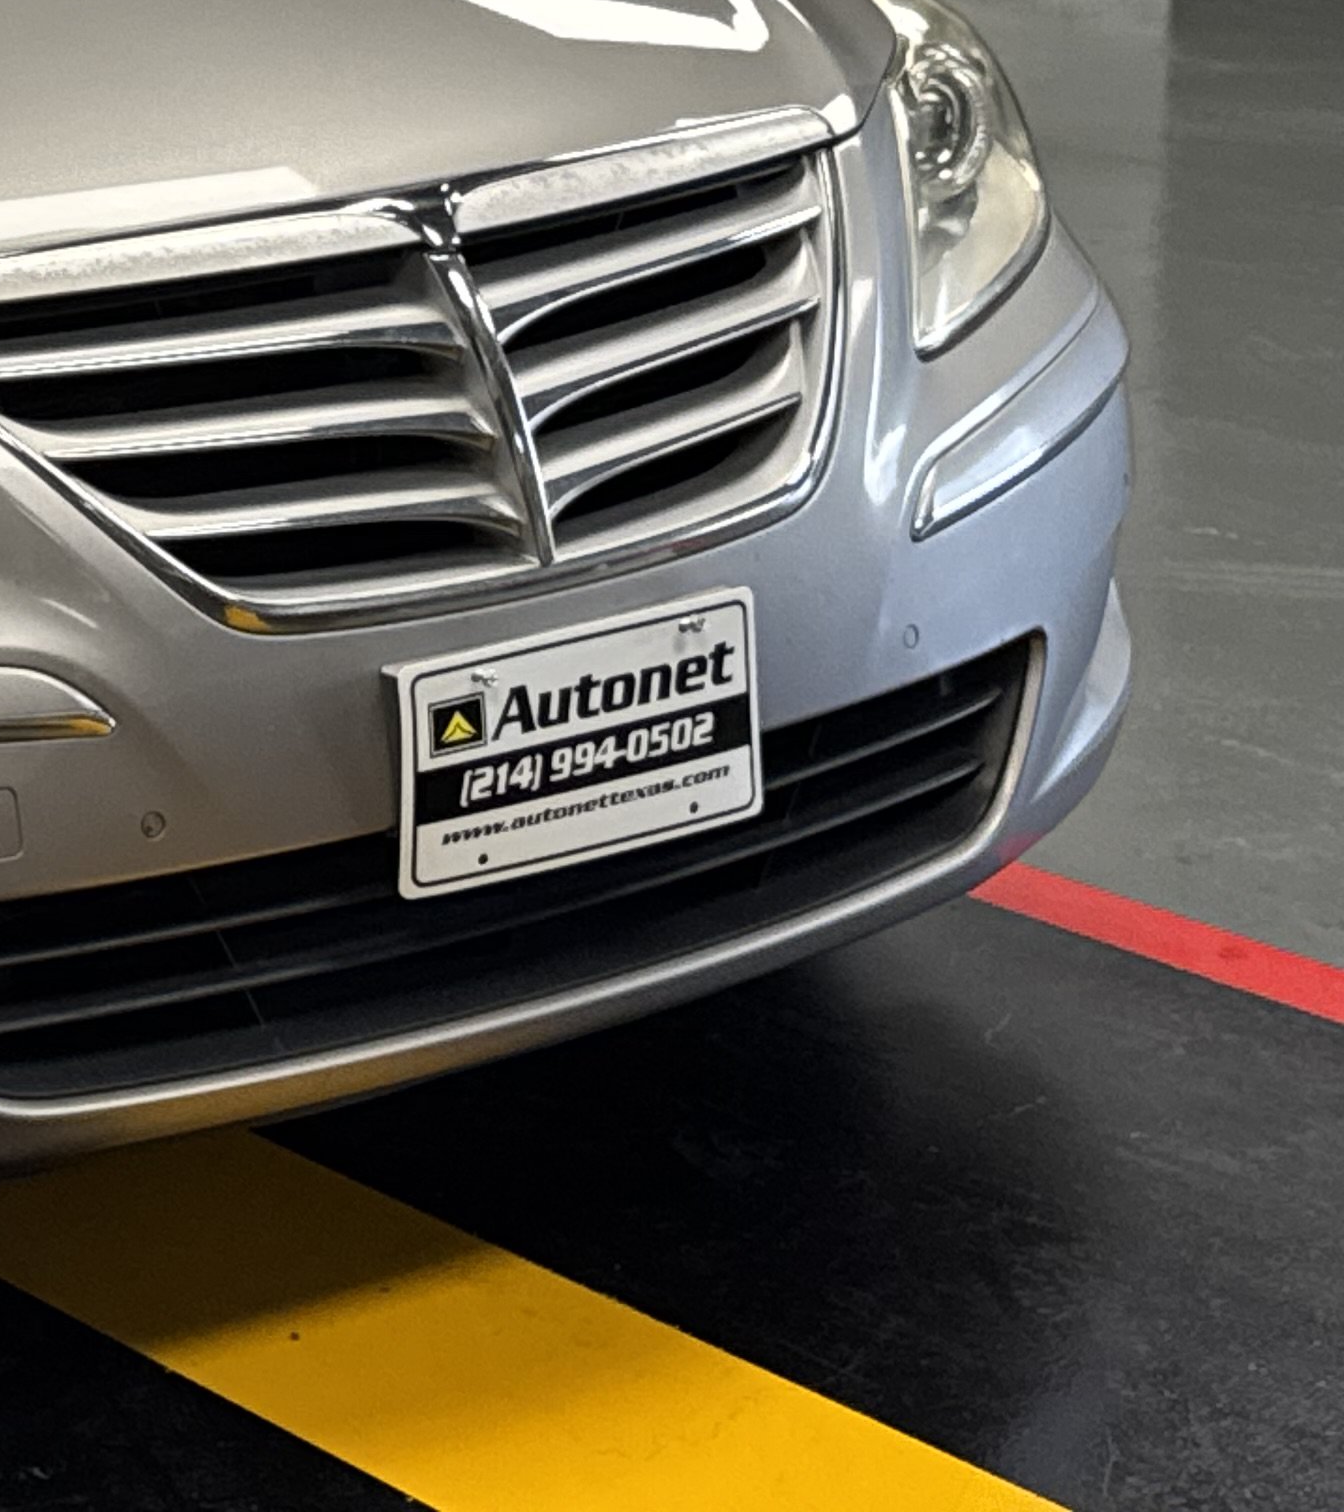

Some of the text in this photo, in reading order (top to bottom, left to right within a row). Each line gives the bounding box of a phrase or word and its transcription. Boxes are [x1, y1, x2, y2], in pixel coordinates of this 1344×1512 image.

[493, 642, 734, 740] Autonet
[442, 765, 730, 845] www.autonettexas.com
[461, 713, 714, 806] (214) 994-0502
